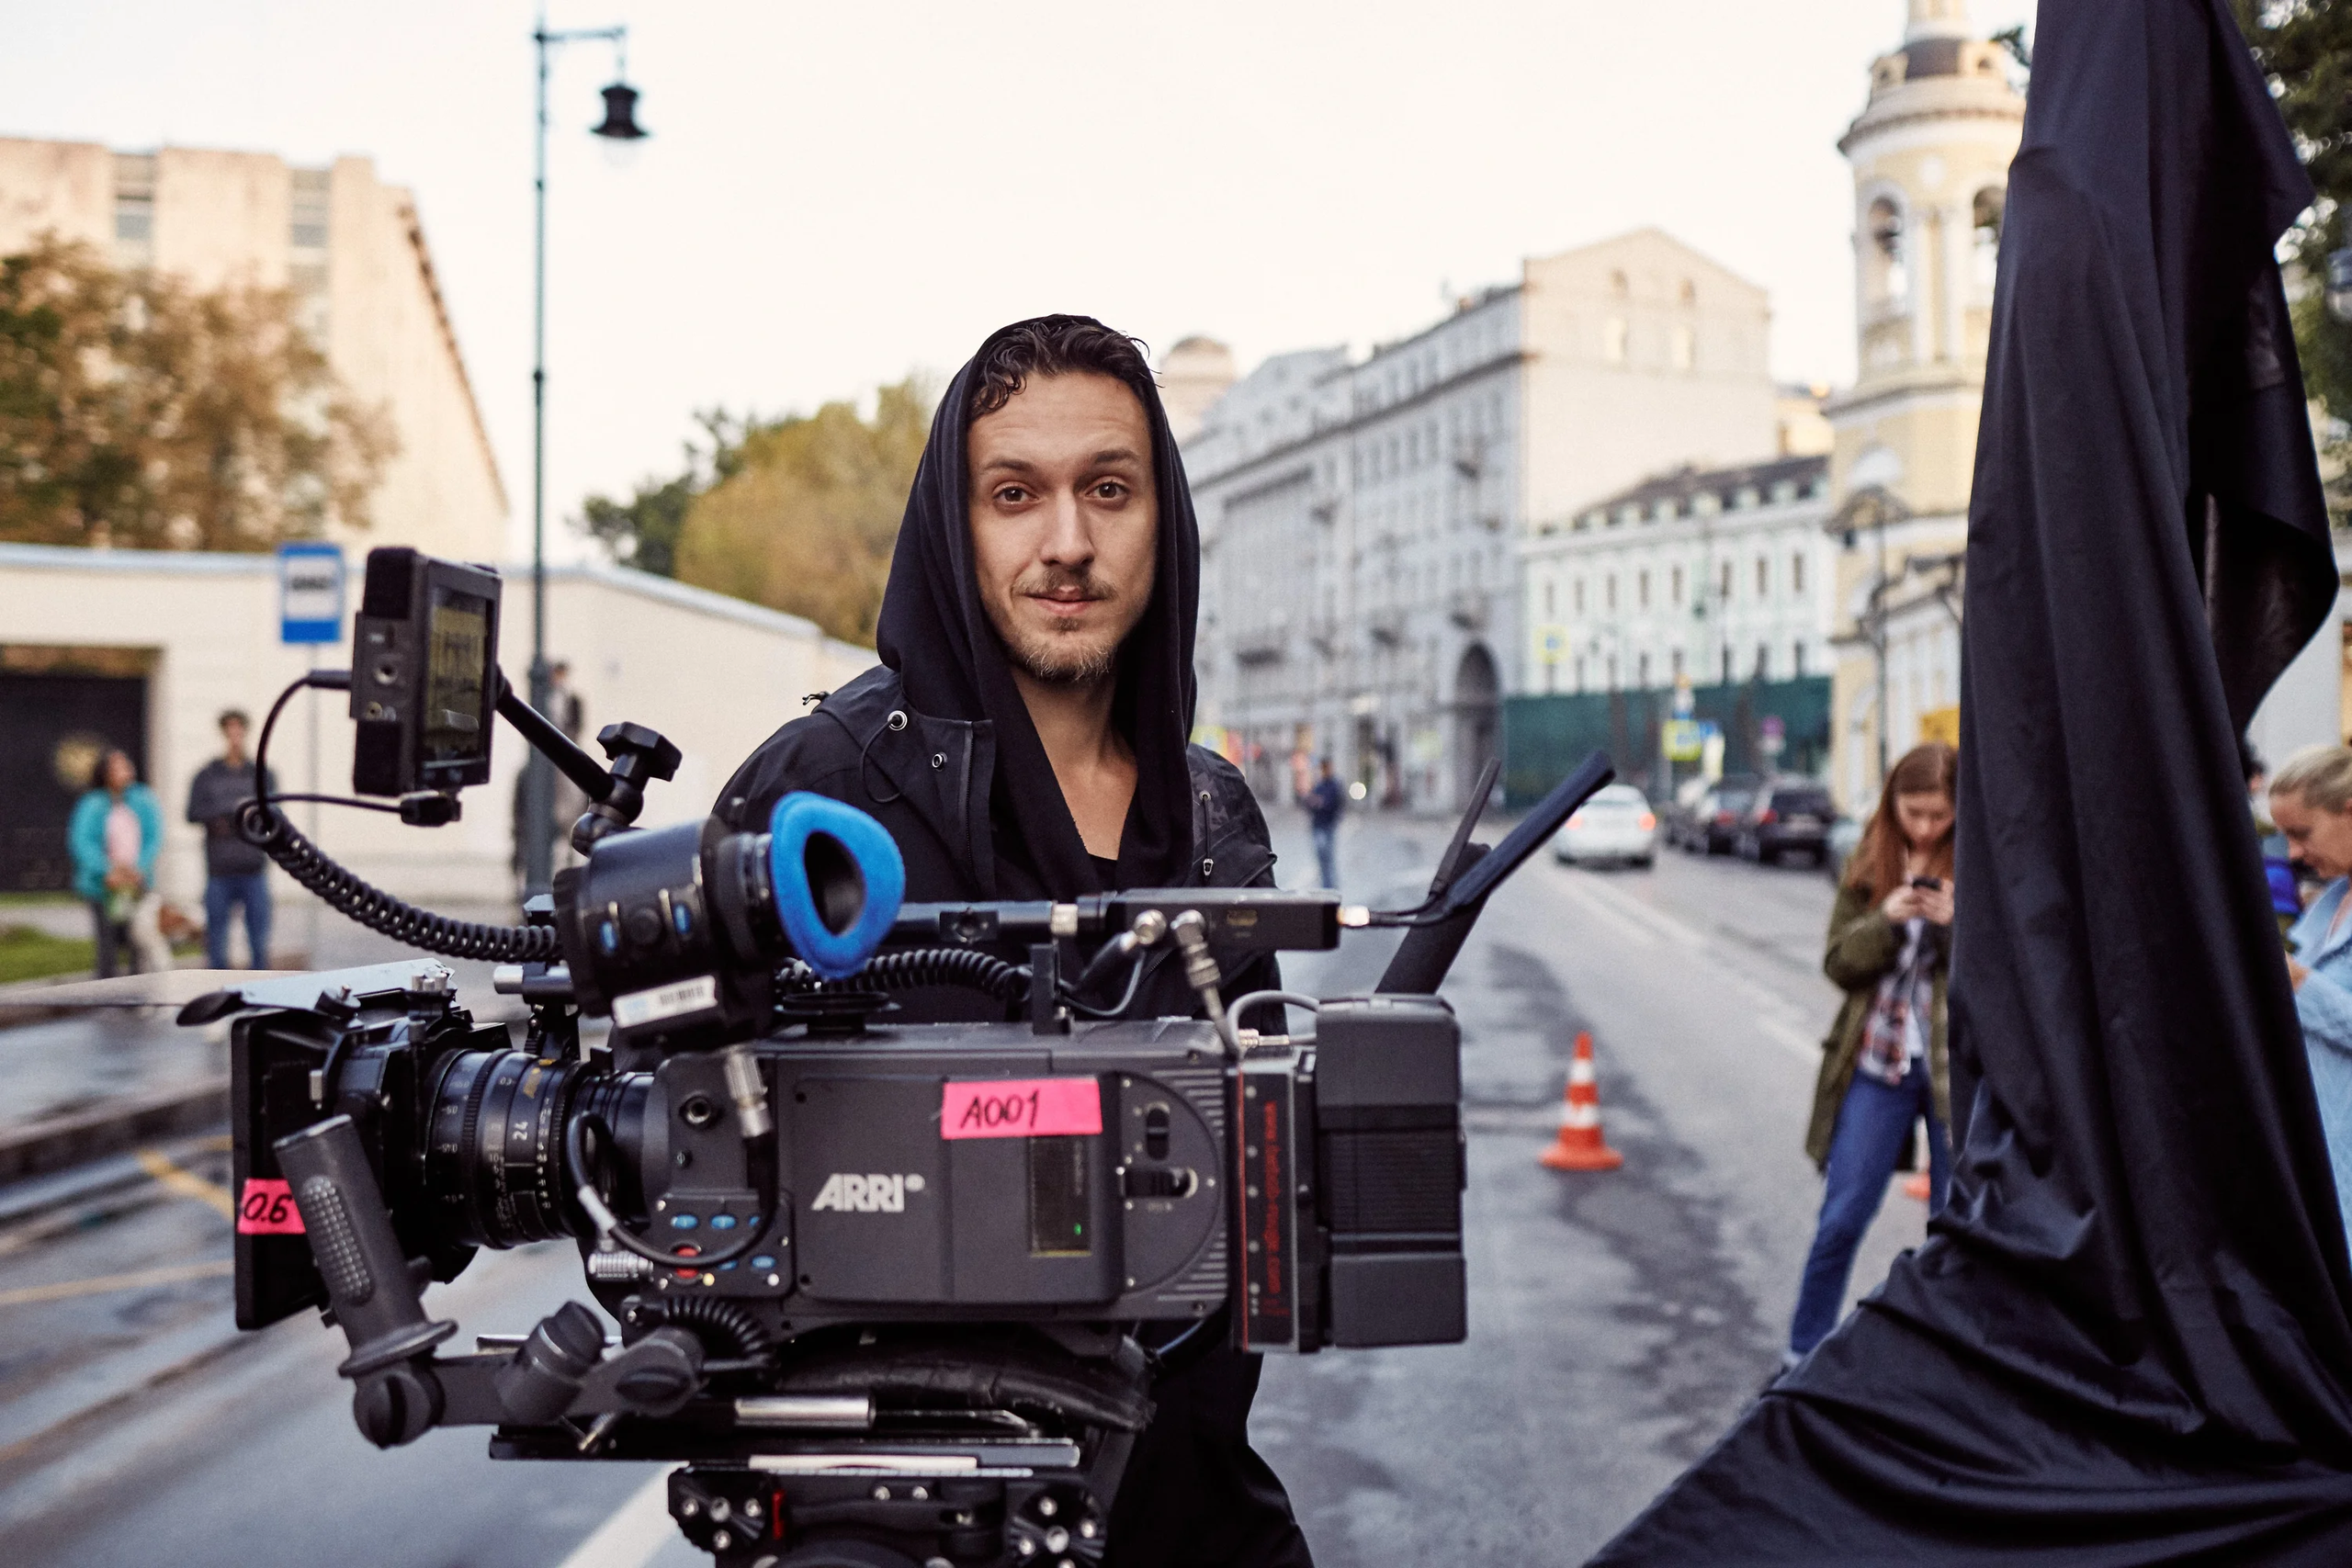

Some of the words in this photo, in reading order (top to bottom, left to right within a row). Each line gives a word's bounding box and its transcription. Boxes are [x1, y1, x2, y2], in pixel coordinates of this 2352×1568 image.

[960, 1089, 1039, 1129] A001
[512, 1121, 529, 1141] 24
[243, 1192, 293, 1224] 0.6
[810, 1172, 906, 1213] ARRI
